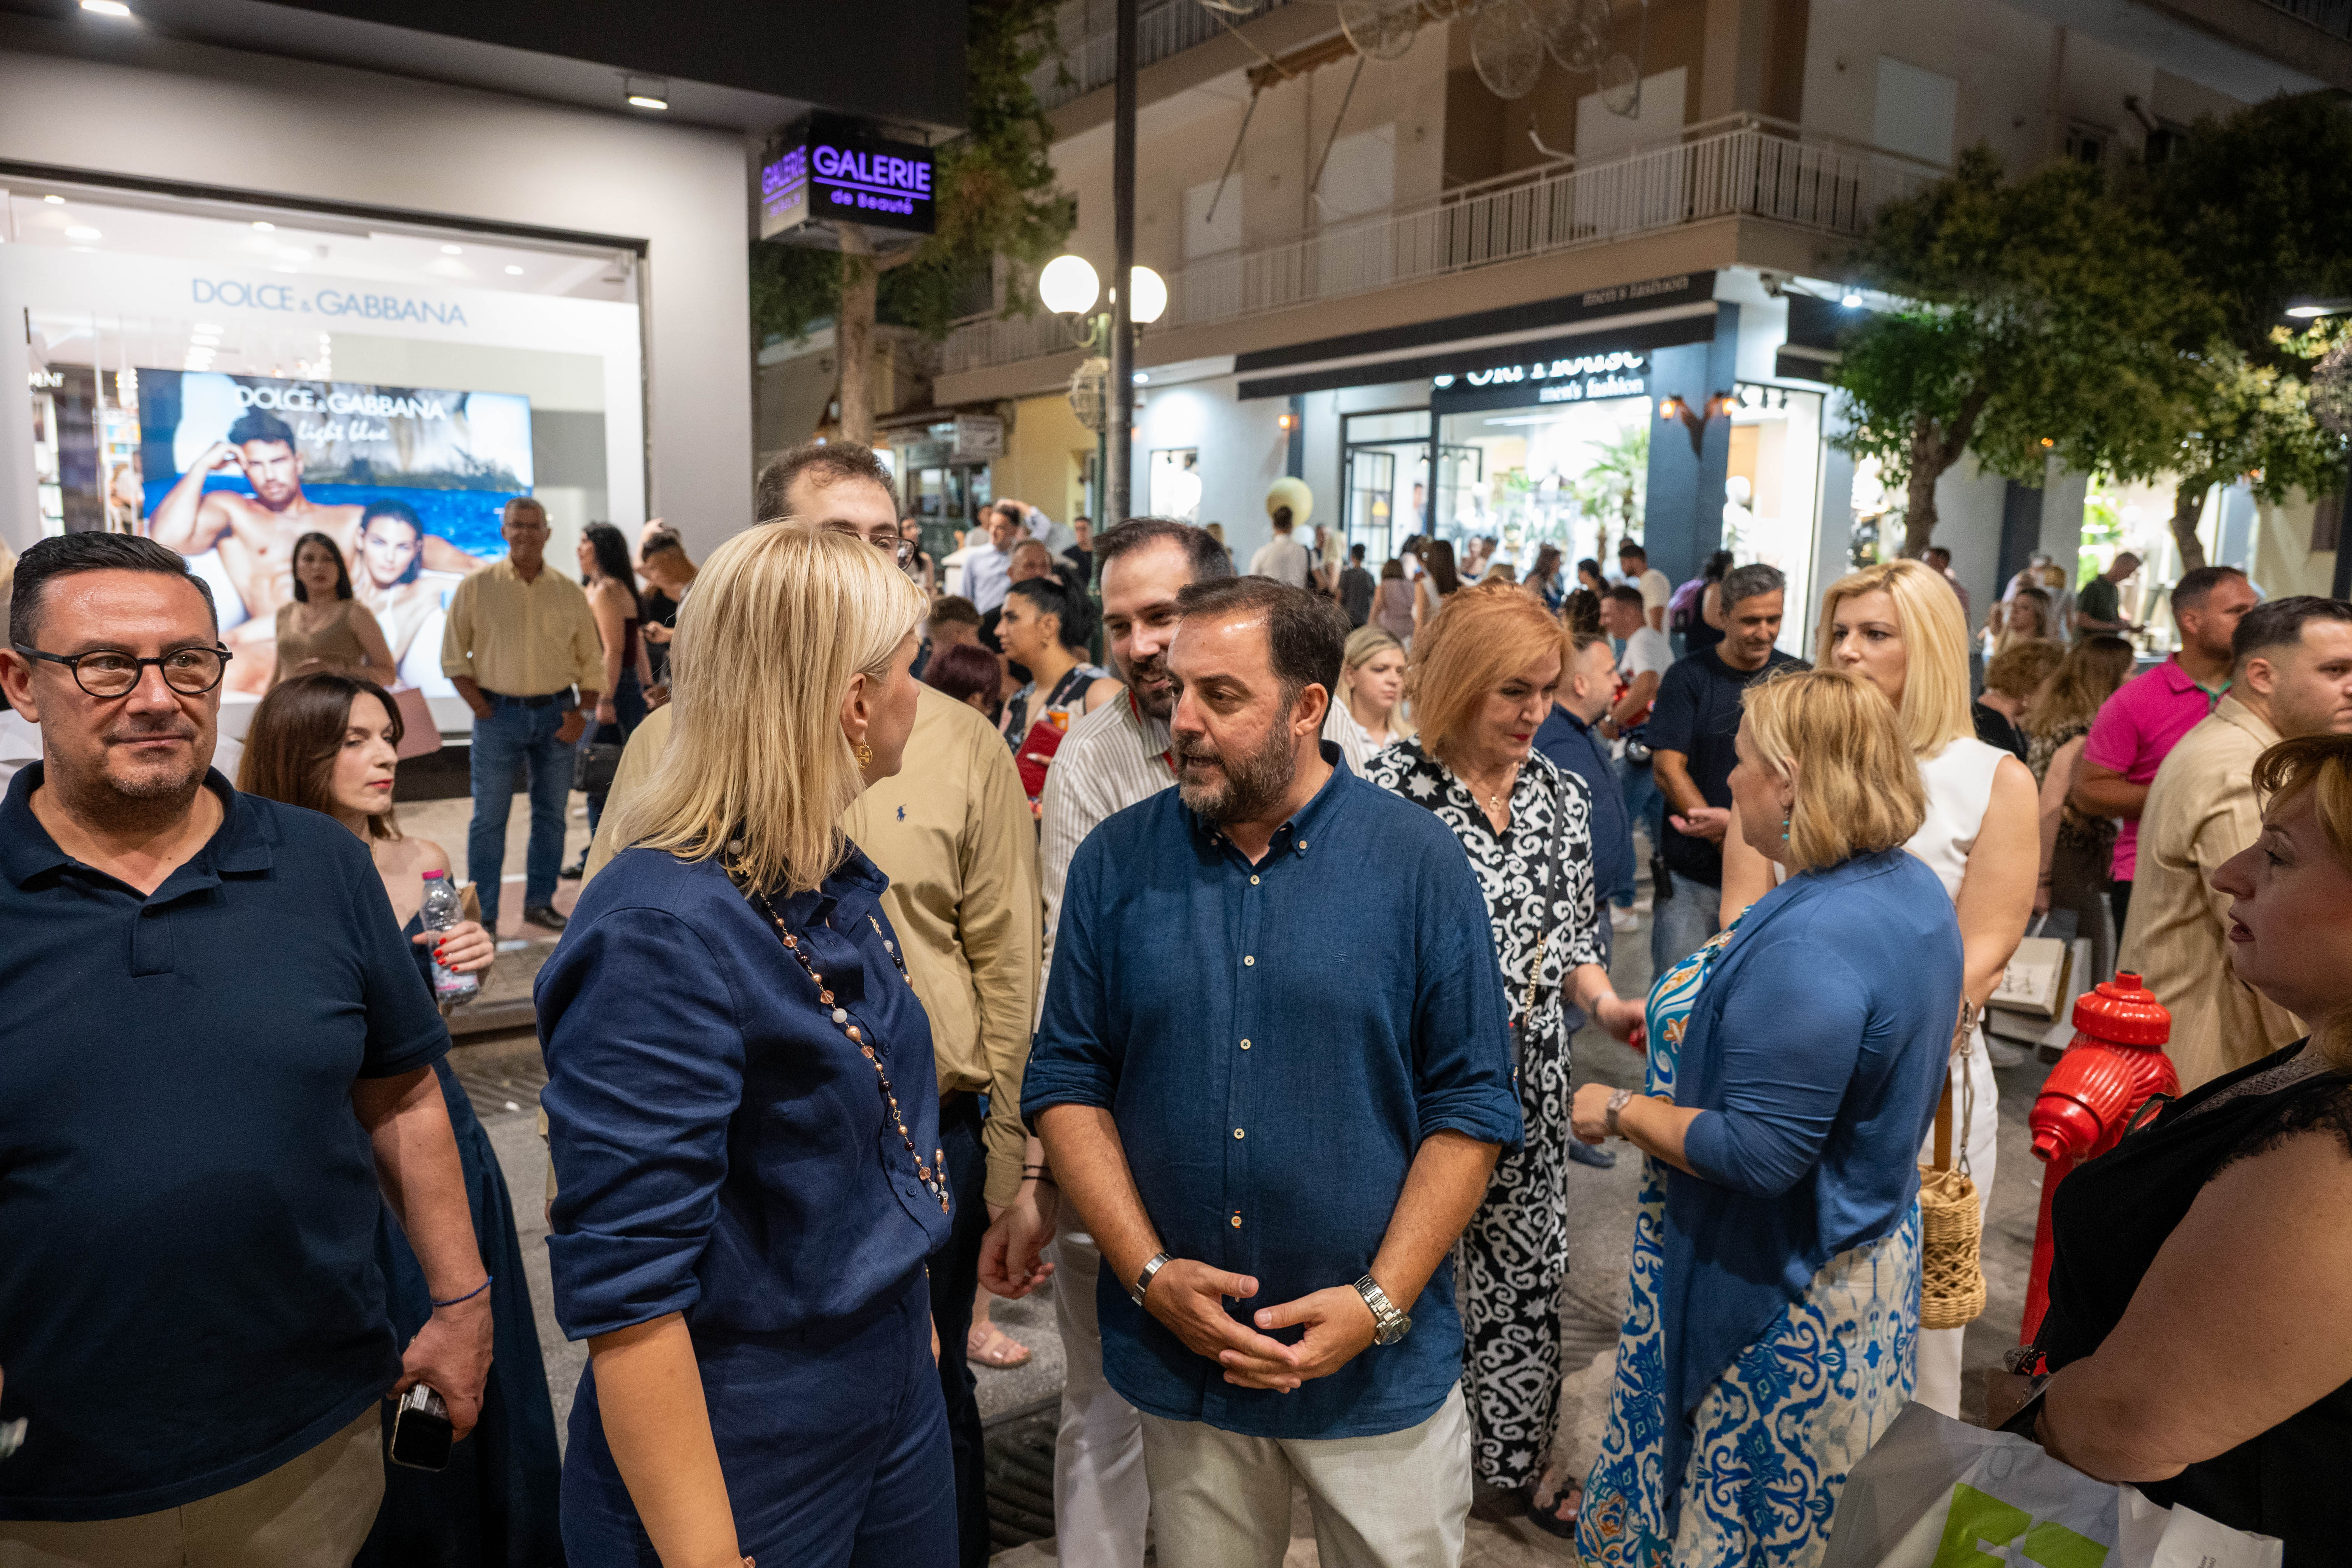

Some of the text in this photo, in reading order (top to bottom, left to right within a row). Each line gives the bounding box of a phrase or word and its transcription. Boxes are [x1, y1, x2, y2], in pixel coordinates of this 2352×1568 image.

[813, 145, 931, 191] GALERIE
[193, 278, 468, 326] DOLCE & GABBANA
[236, 385, 314, 413] DOLCE
[327, 392, 447, 420] GABBANA
[1586, 374, 1644, 398] fashion
